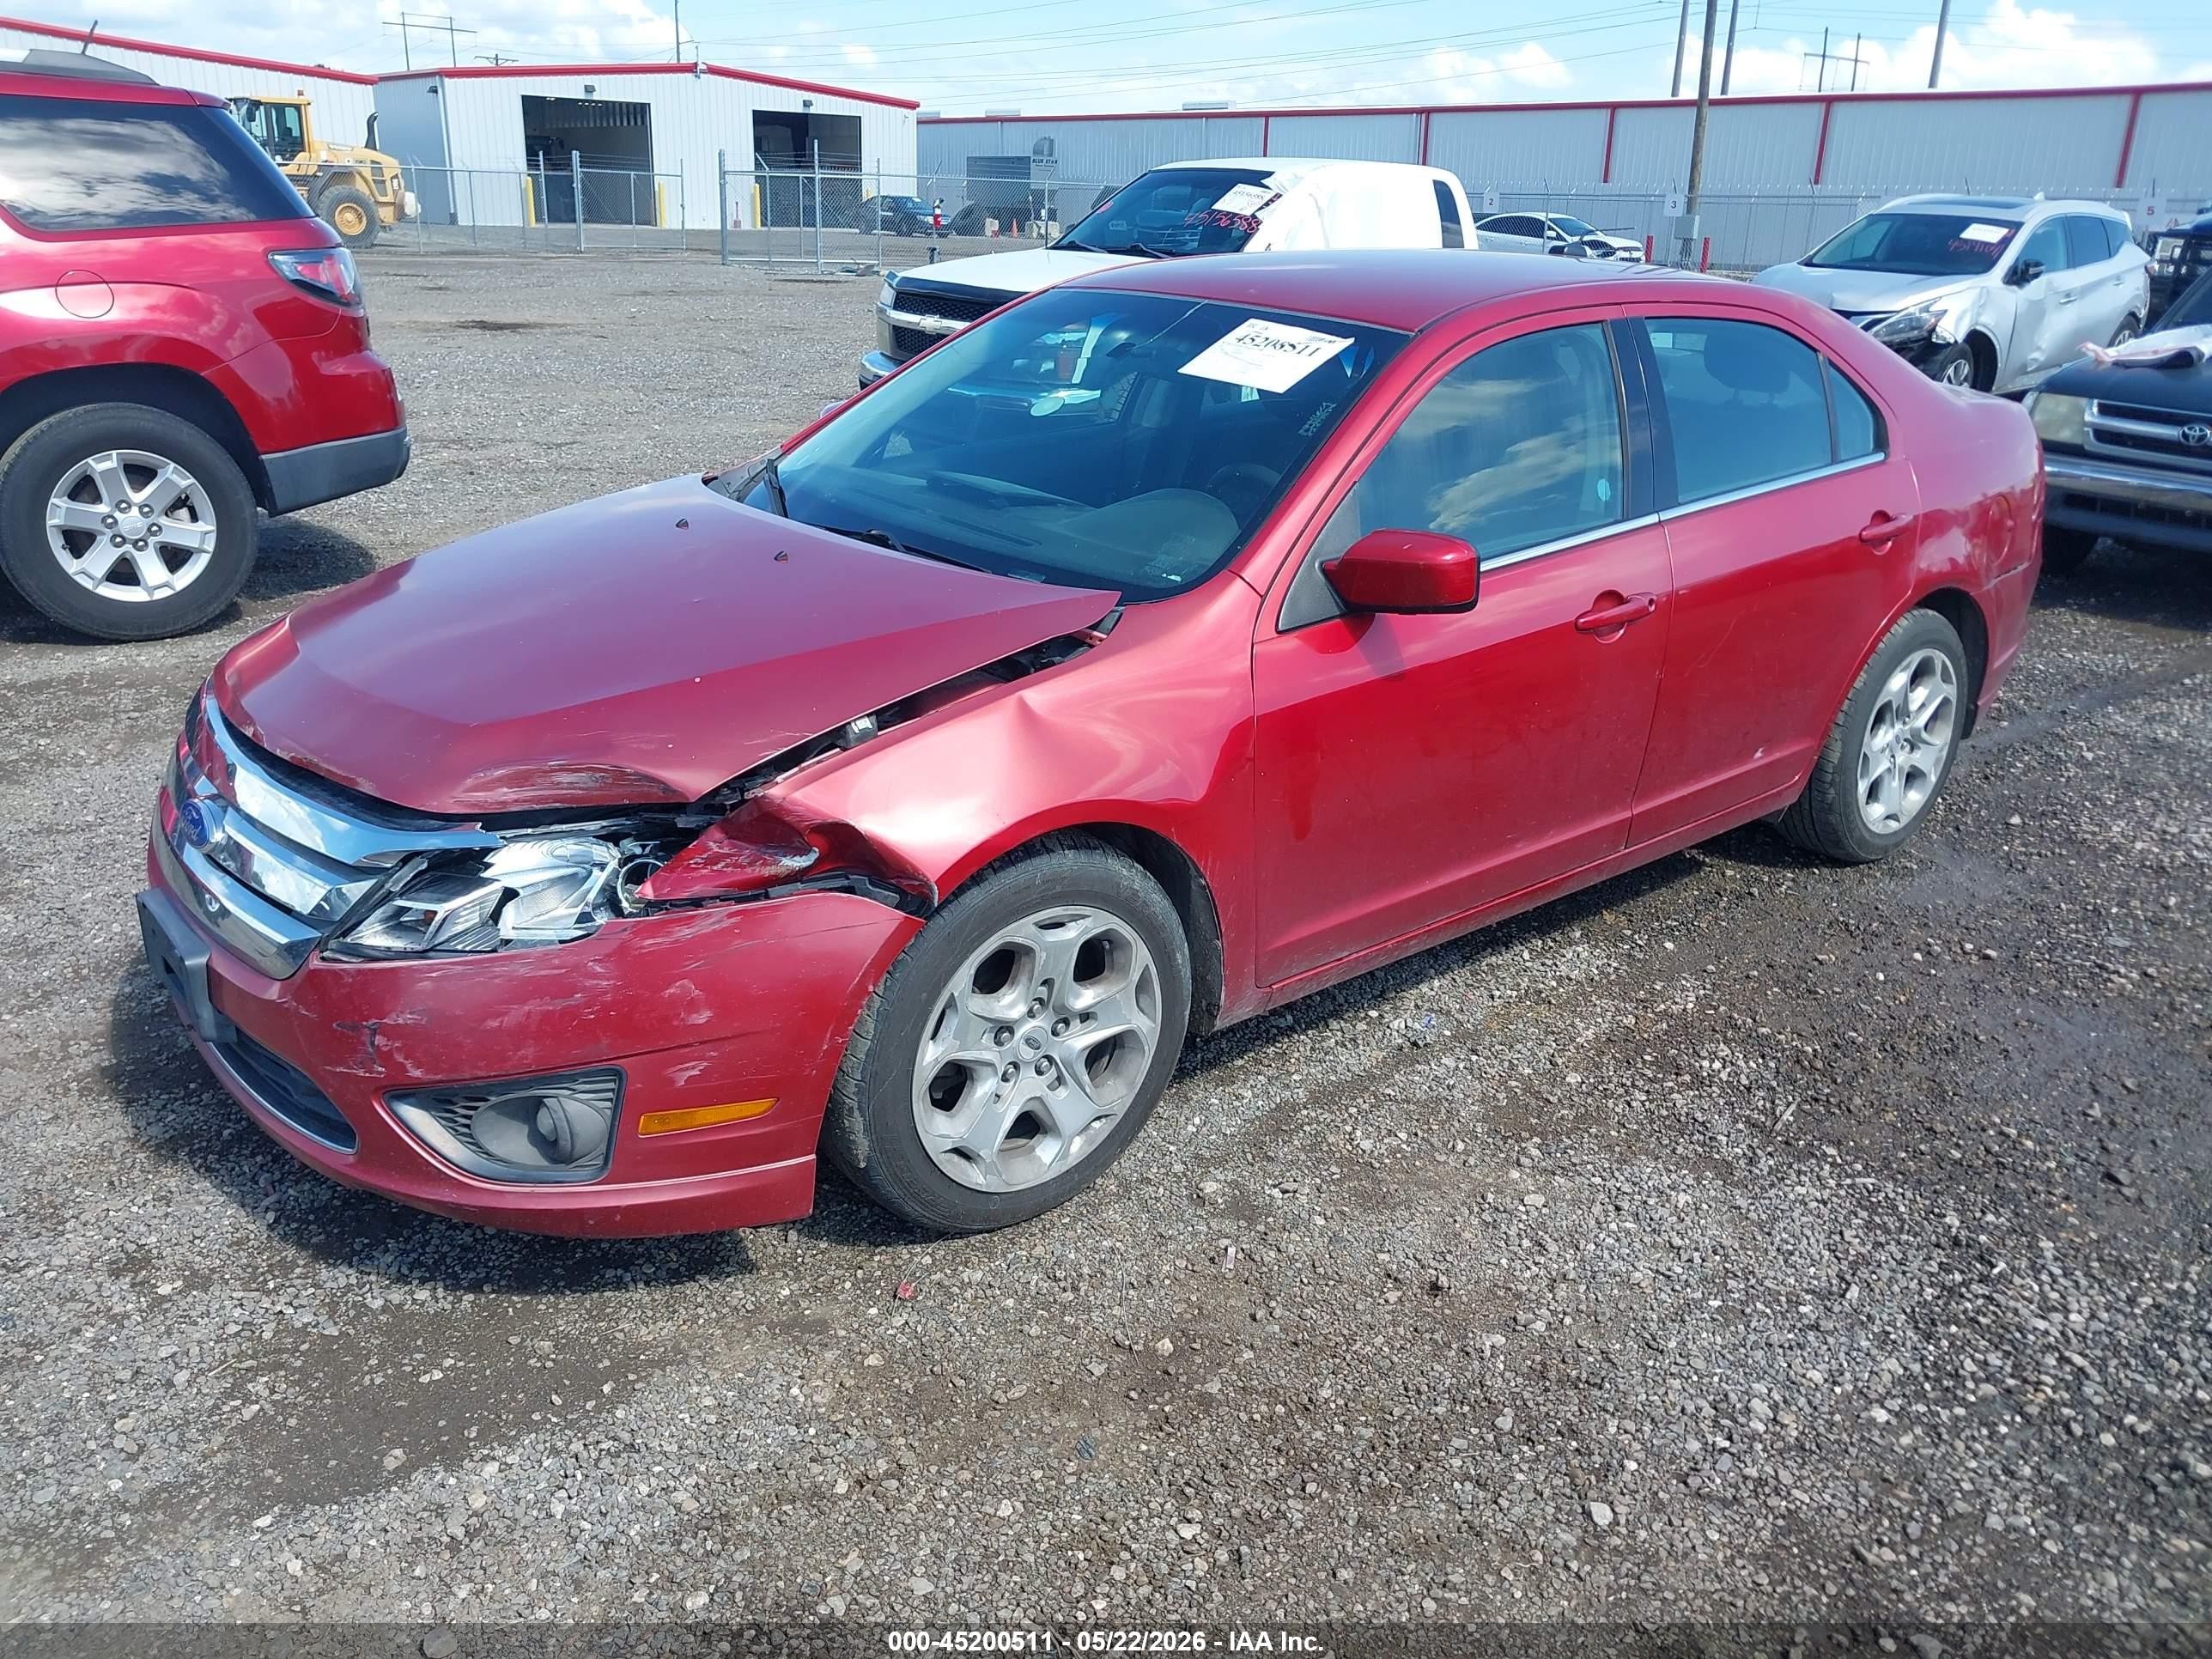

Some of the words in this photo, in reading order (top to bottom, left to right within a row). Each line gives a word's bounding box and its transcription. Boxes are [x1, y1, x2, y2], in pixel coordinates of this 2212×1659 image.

[1489, 198, 1494, 206] 2
[1670, 200, 1677, 209] 3
[2147, 206, 2154, 216] 5
[1183, 210, 1262, 233] 45156588
[180, 805, 203, 841] Ford
